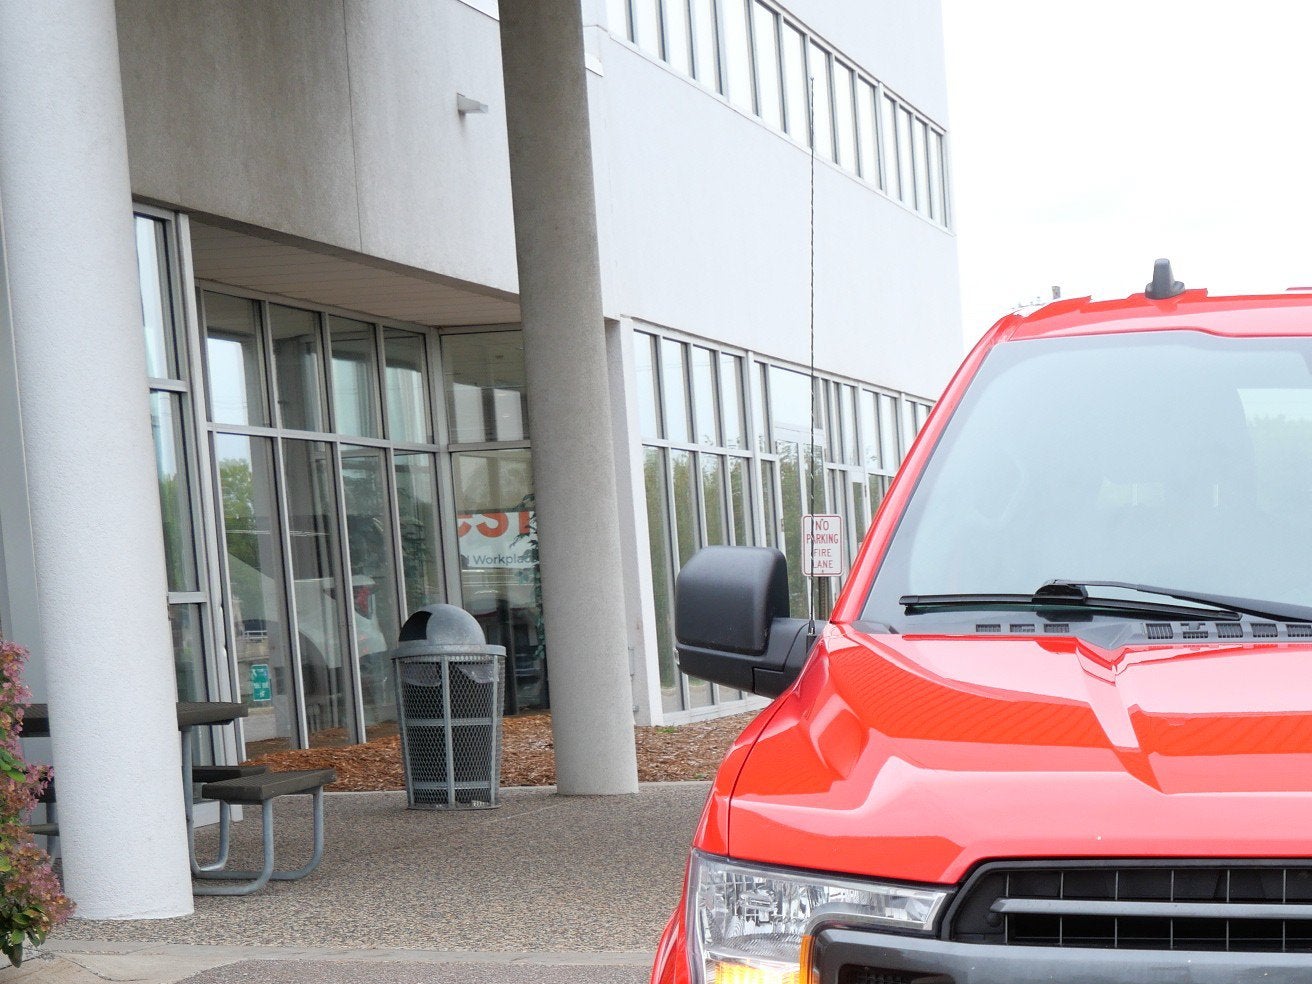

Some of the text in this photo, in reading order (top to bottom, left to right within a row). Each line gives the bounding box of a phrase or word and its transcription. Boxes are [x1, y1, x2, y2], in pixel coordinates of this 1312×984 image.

[815, 520, 830, 531] NO
[806, 533, 839, 544] PARKING
[813, 548, 832, 558] FIRE
